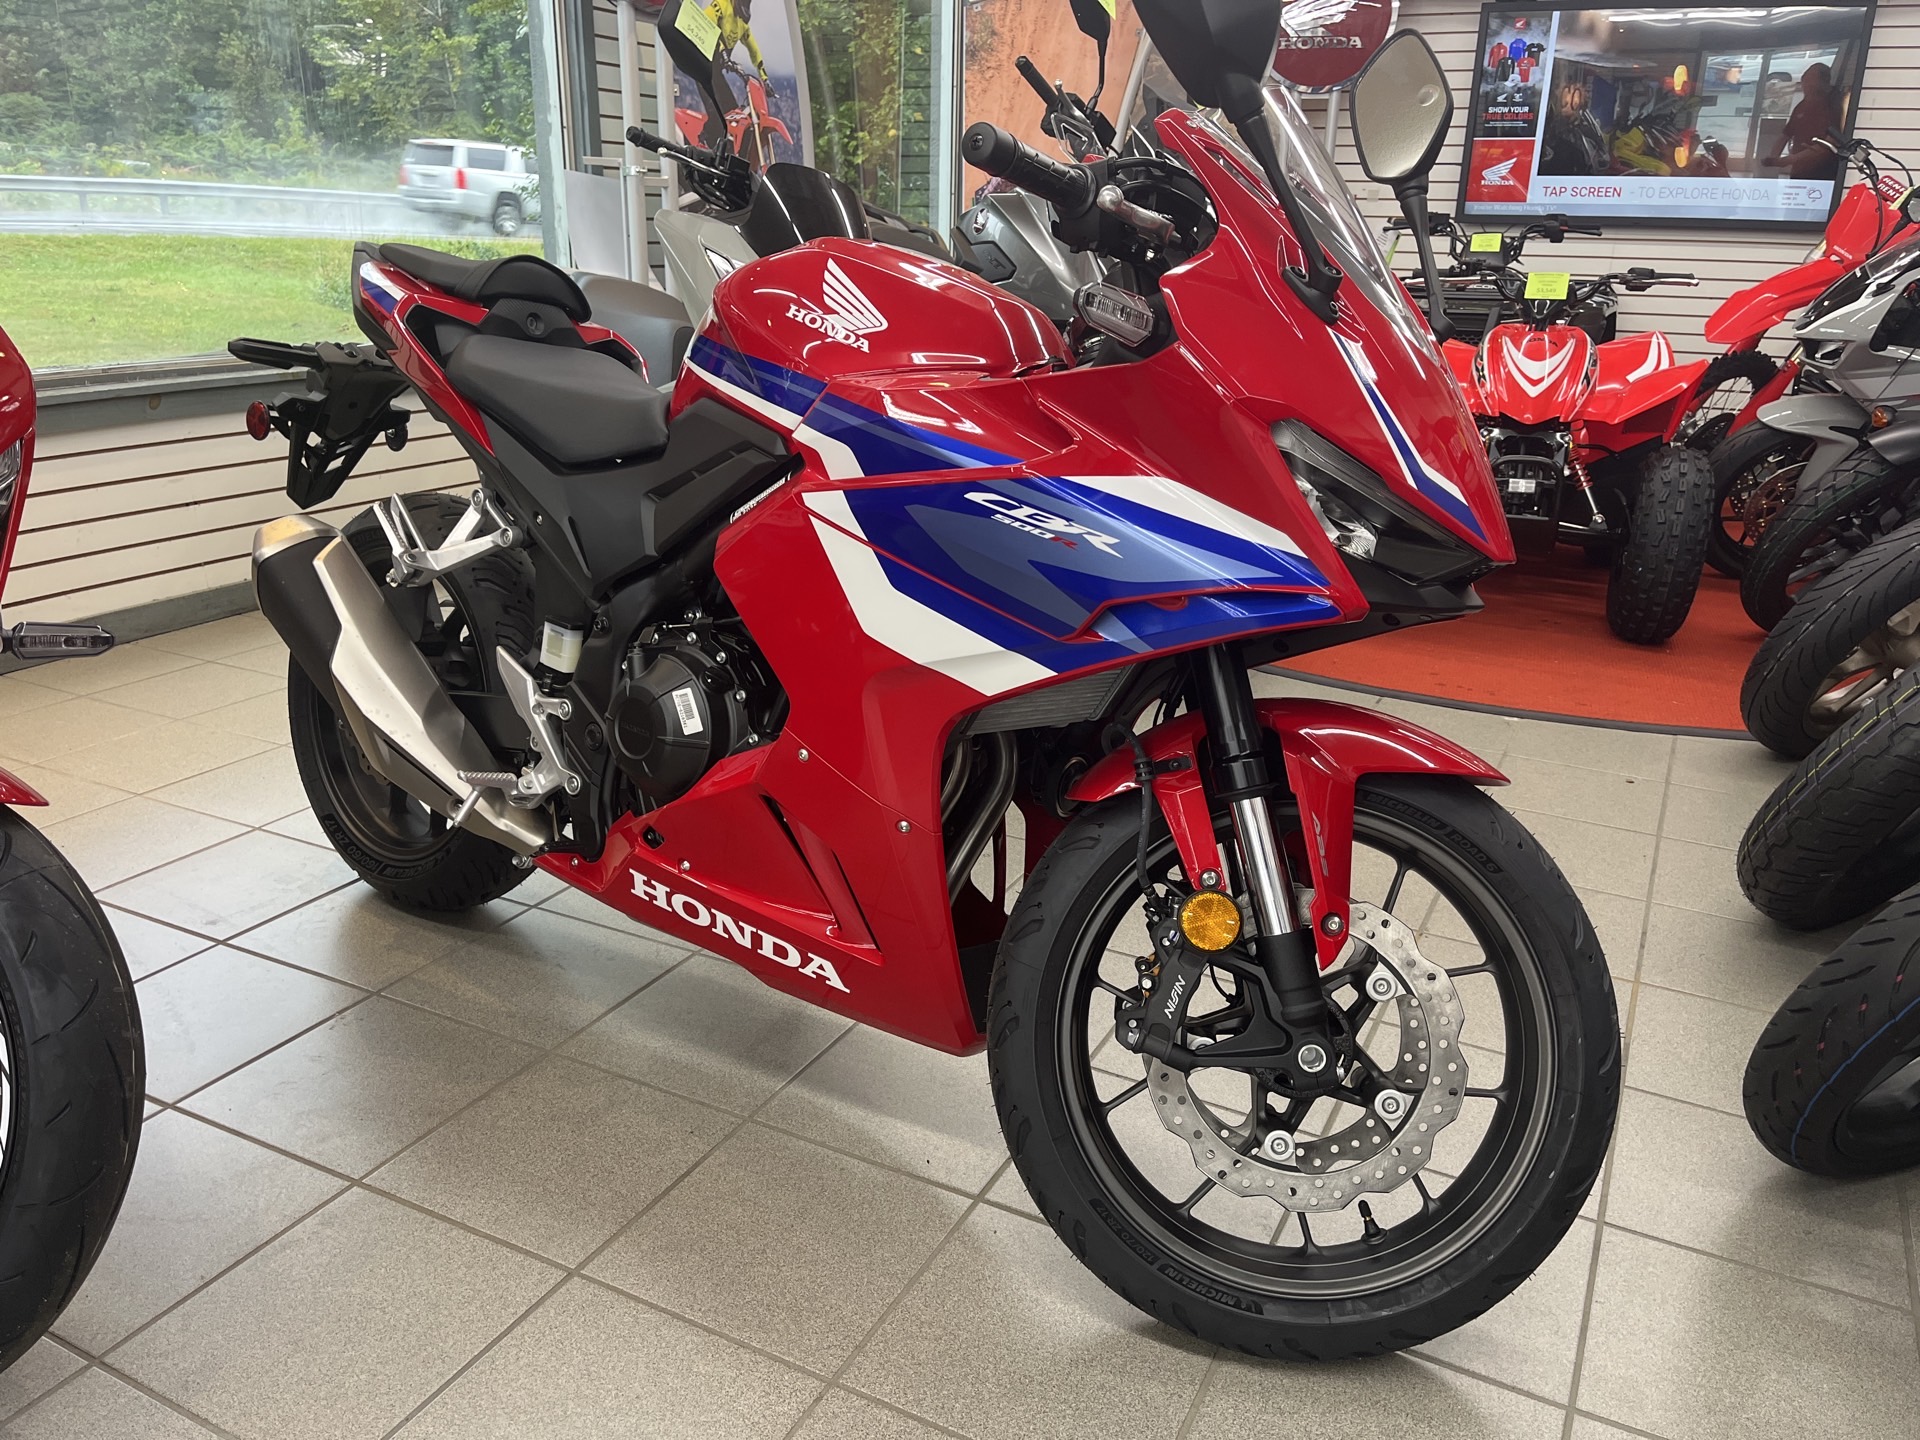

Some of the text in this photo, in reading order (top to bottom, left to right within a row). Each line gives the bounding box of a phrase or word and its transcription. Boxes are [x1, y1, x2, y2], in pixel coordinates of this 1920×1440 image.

[1278, 36, 1363, 50] HONDA
[1488, 106, 1530, 114] SHOW YOUR
[1542, 186, 1568, 197] TAP
[1570, 186, 1622, 198] SCREEN
[1638, 186, 1656, 199] TO
[1658, 187, 1719, 200] EXPLORE
[1721, 188, 1770, 201] HONDA
[785, 302, 870, 354] HONDA
[963, 491, 1124, 559] CBR
[990, 513, 1079, 551] 500R
[1367, 793, 1440, 829] MICHELIN
[325, 818, 379, 870] 160/60 ZR 17
[1450, 833, 1487, 864] ROAD
[629, 868, 850, 994] HONDA
[1096, 1206, 1157, 1262] 120/70 ZR 17
[1164, 1265, 1238, 1305] MICHELIN
